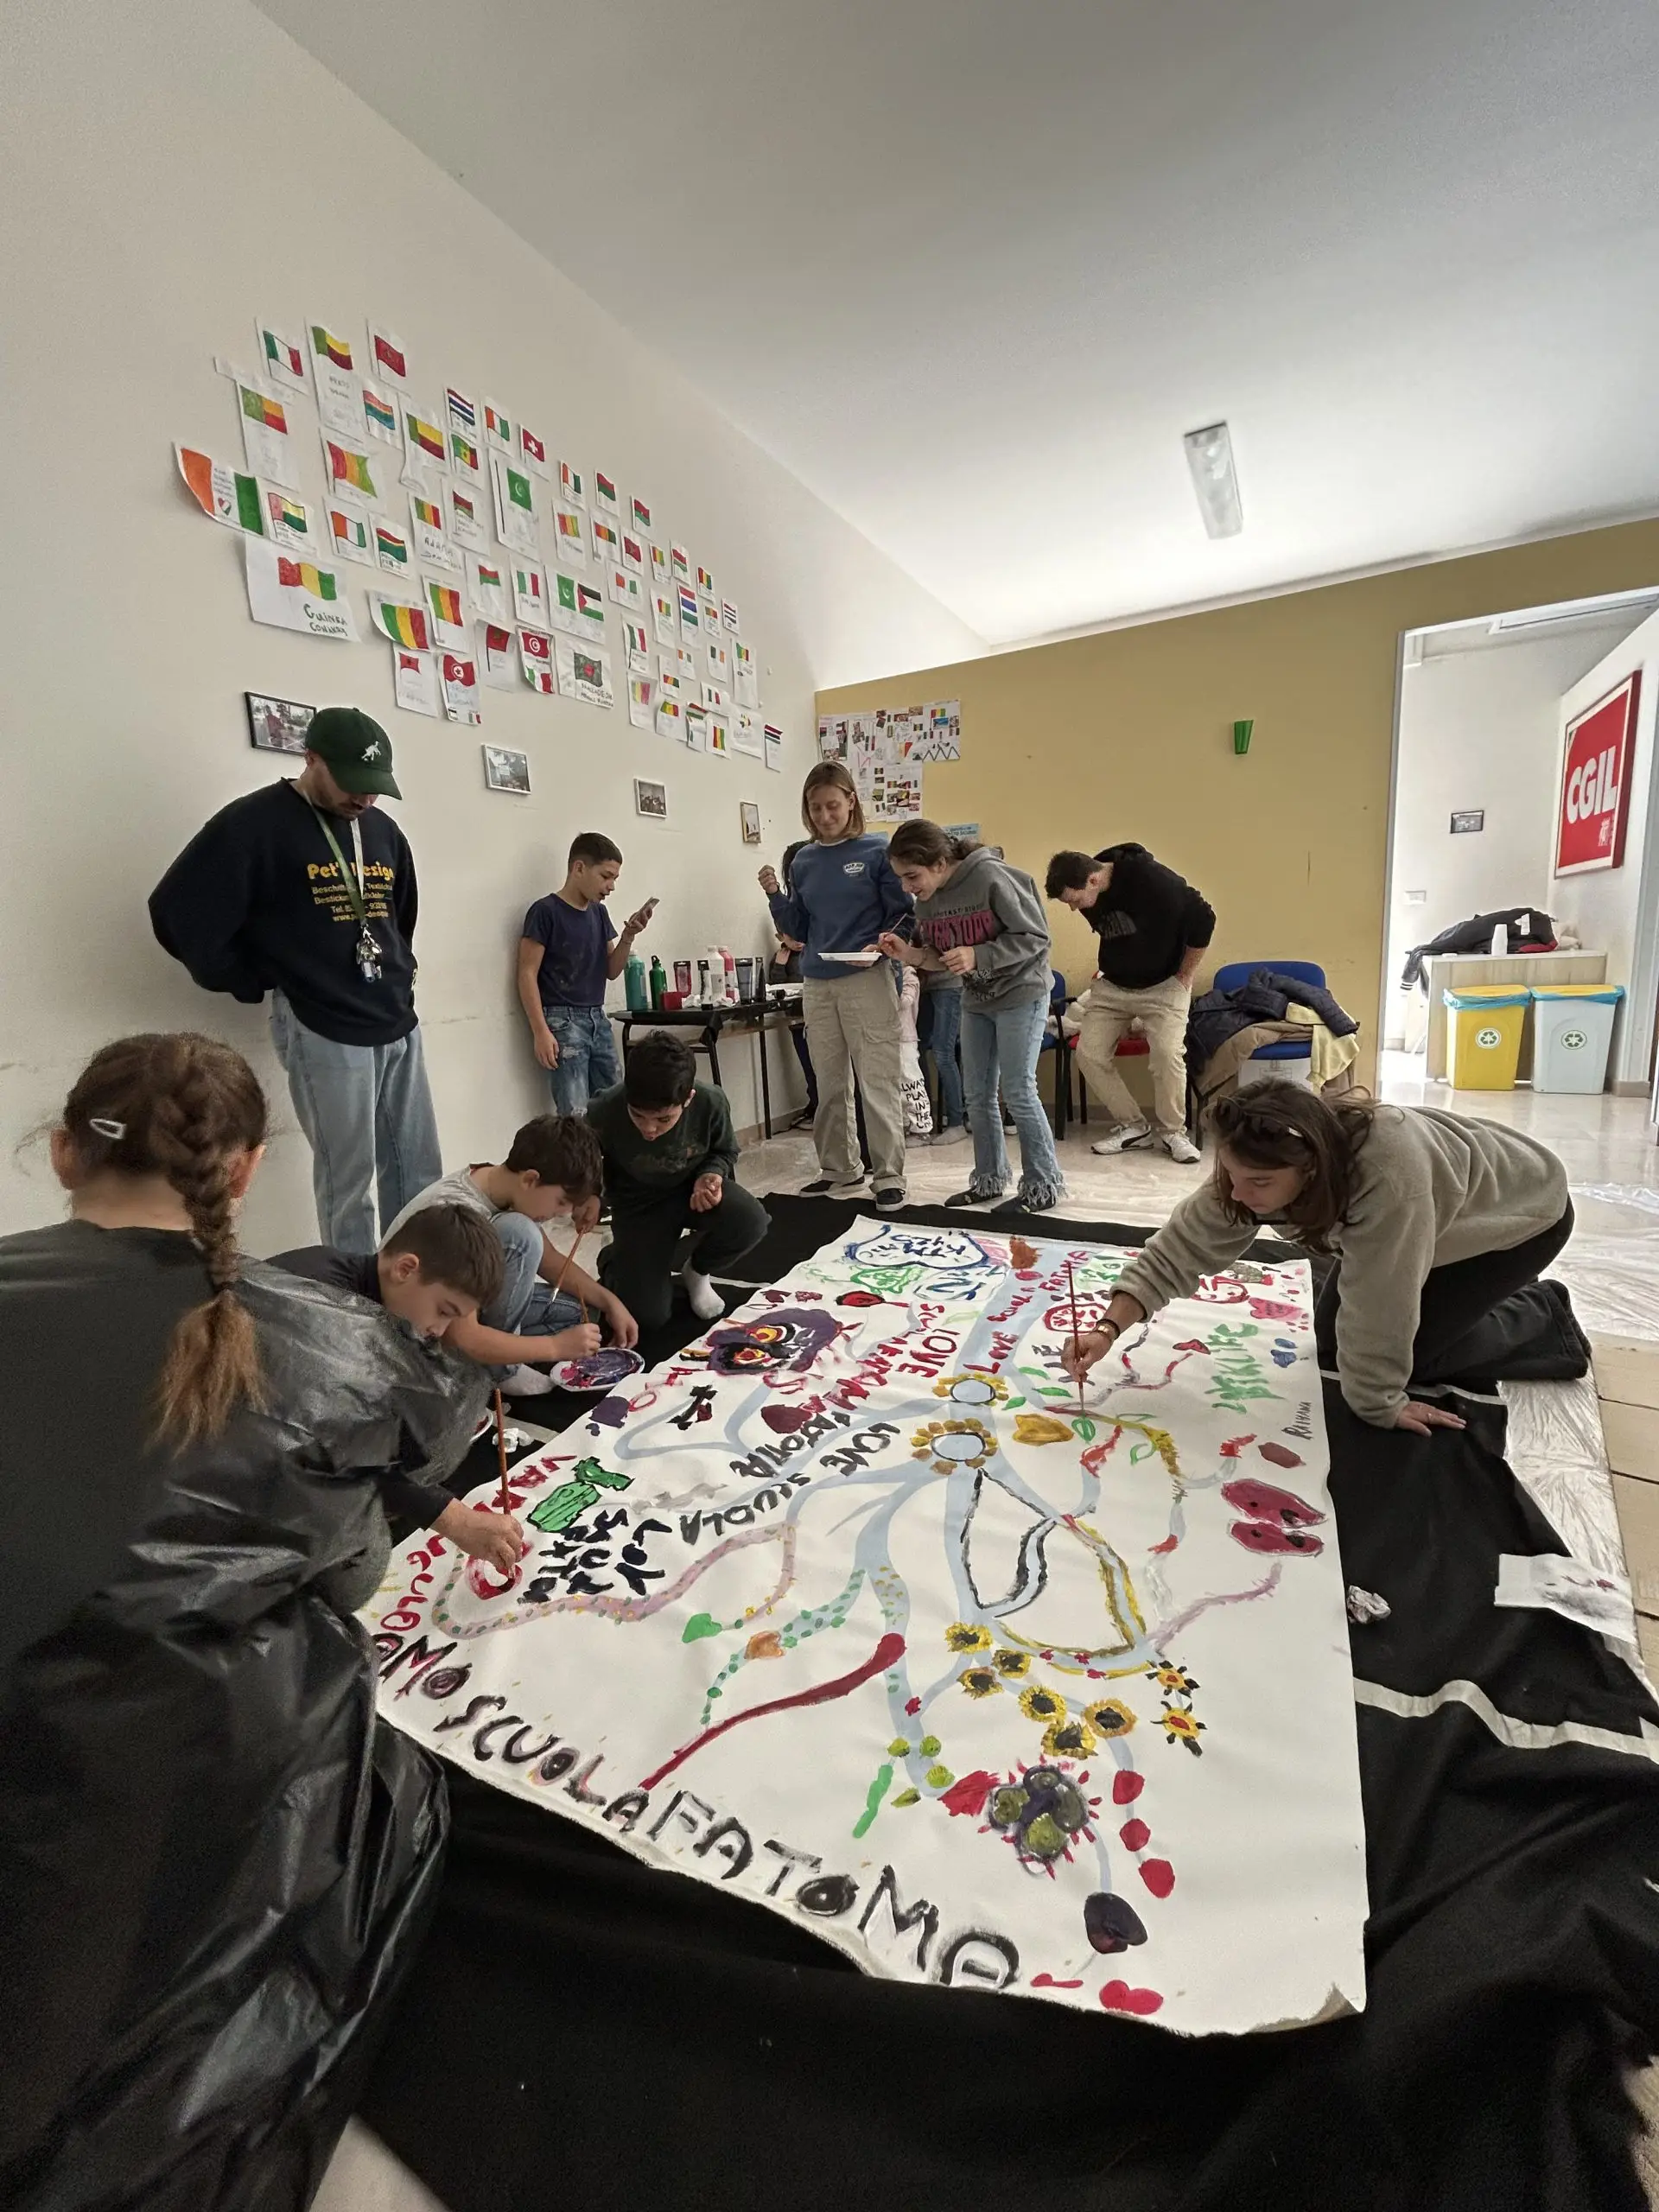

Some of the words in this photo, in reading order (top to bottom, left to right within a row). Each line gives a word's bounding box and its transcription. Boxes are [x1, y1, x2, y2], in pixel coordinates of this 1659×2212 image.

[1567, 745, 1618, 824] CGIL
[895, 1327, 961, 1378] LOVE
[819, 1422, 901, 1477] LOVE
[679, 1472, 811, 1545] SCUOLA
[432, 1694, 650, 1834] SCUOLA
[647, 1789, 1021, 1987] FATOMA
